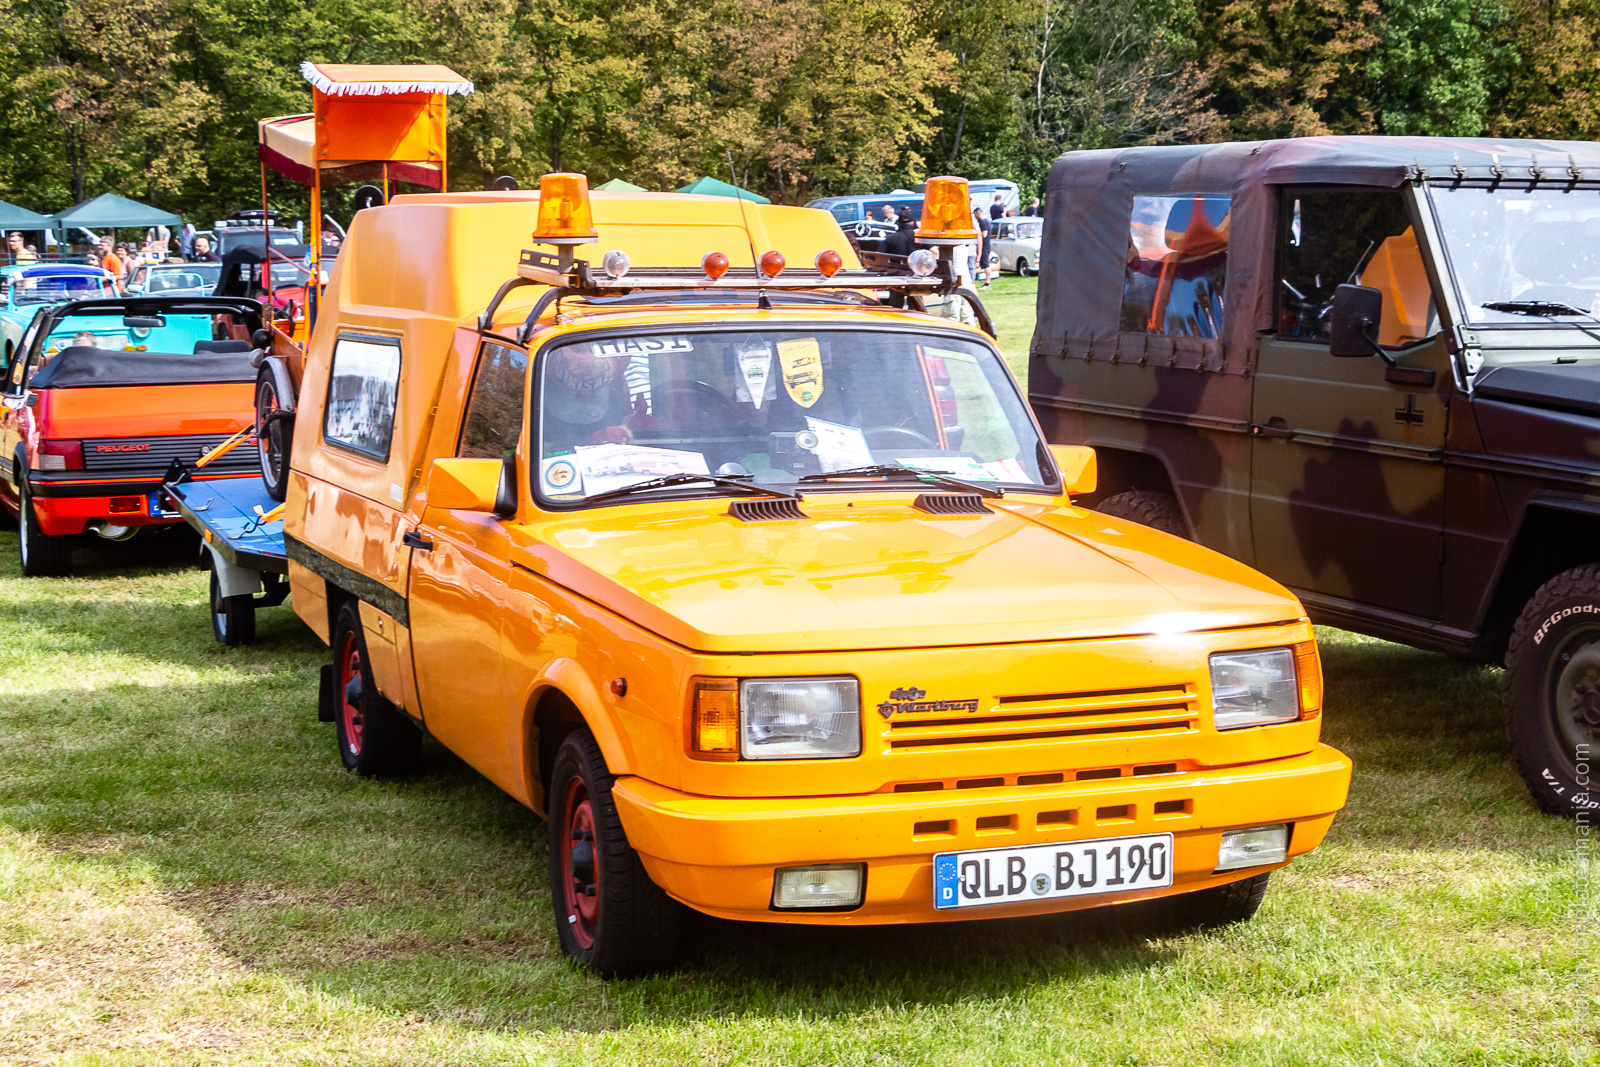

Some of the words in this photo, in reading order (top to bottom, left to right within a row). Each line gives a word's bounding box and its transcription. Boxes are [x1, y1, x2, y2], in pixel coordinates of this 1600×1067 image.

[96, 443, 151, 453] PEUGEOT
[896, 699, 979, 713] Wartburg
[942, 887, 953, 900] D
[961, 856, 1027, 899] QLB
